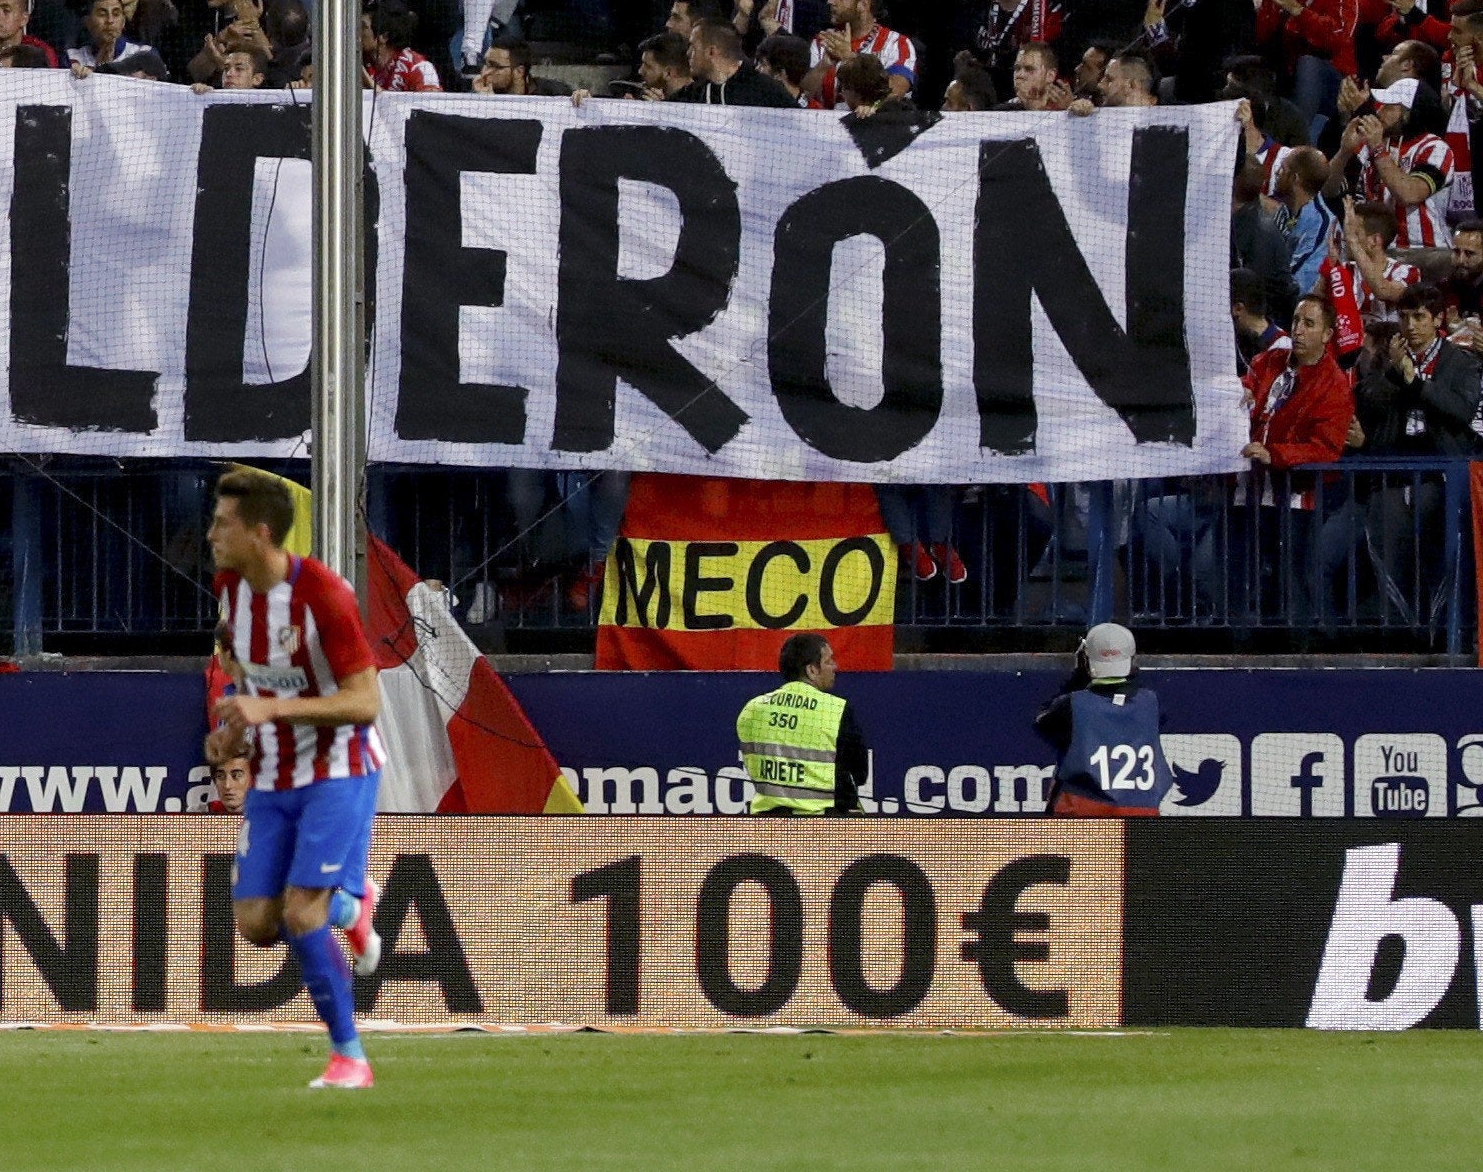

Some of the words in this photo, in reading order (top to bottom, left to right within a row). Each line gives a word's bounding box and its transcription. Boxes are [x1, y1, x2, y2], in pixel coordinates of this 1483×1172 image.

[613, 534, 886, 631] MECO
[768, 711, 799, 731] 350
[1089, 743, 1156, 792] 123
[1380, 744, 1419, 773] You
[1373, 781, 1428, 812] Tube
[569, 853, 1073, 1019] 100€
[1304, 841, 1483, 1032] b
